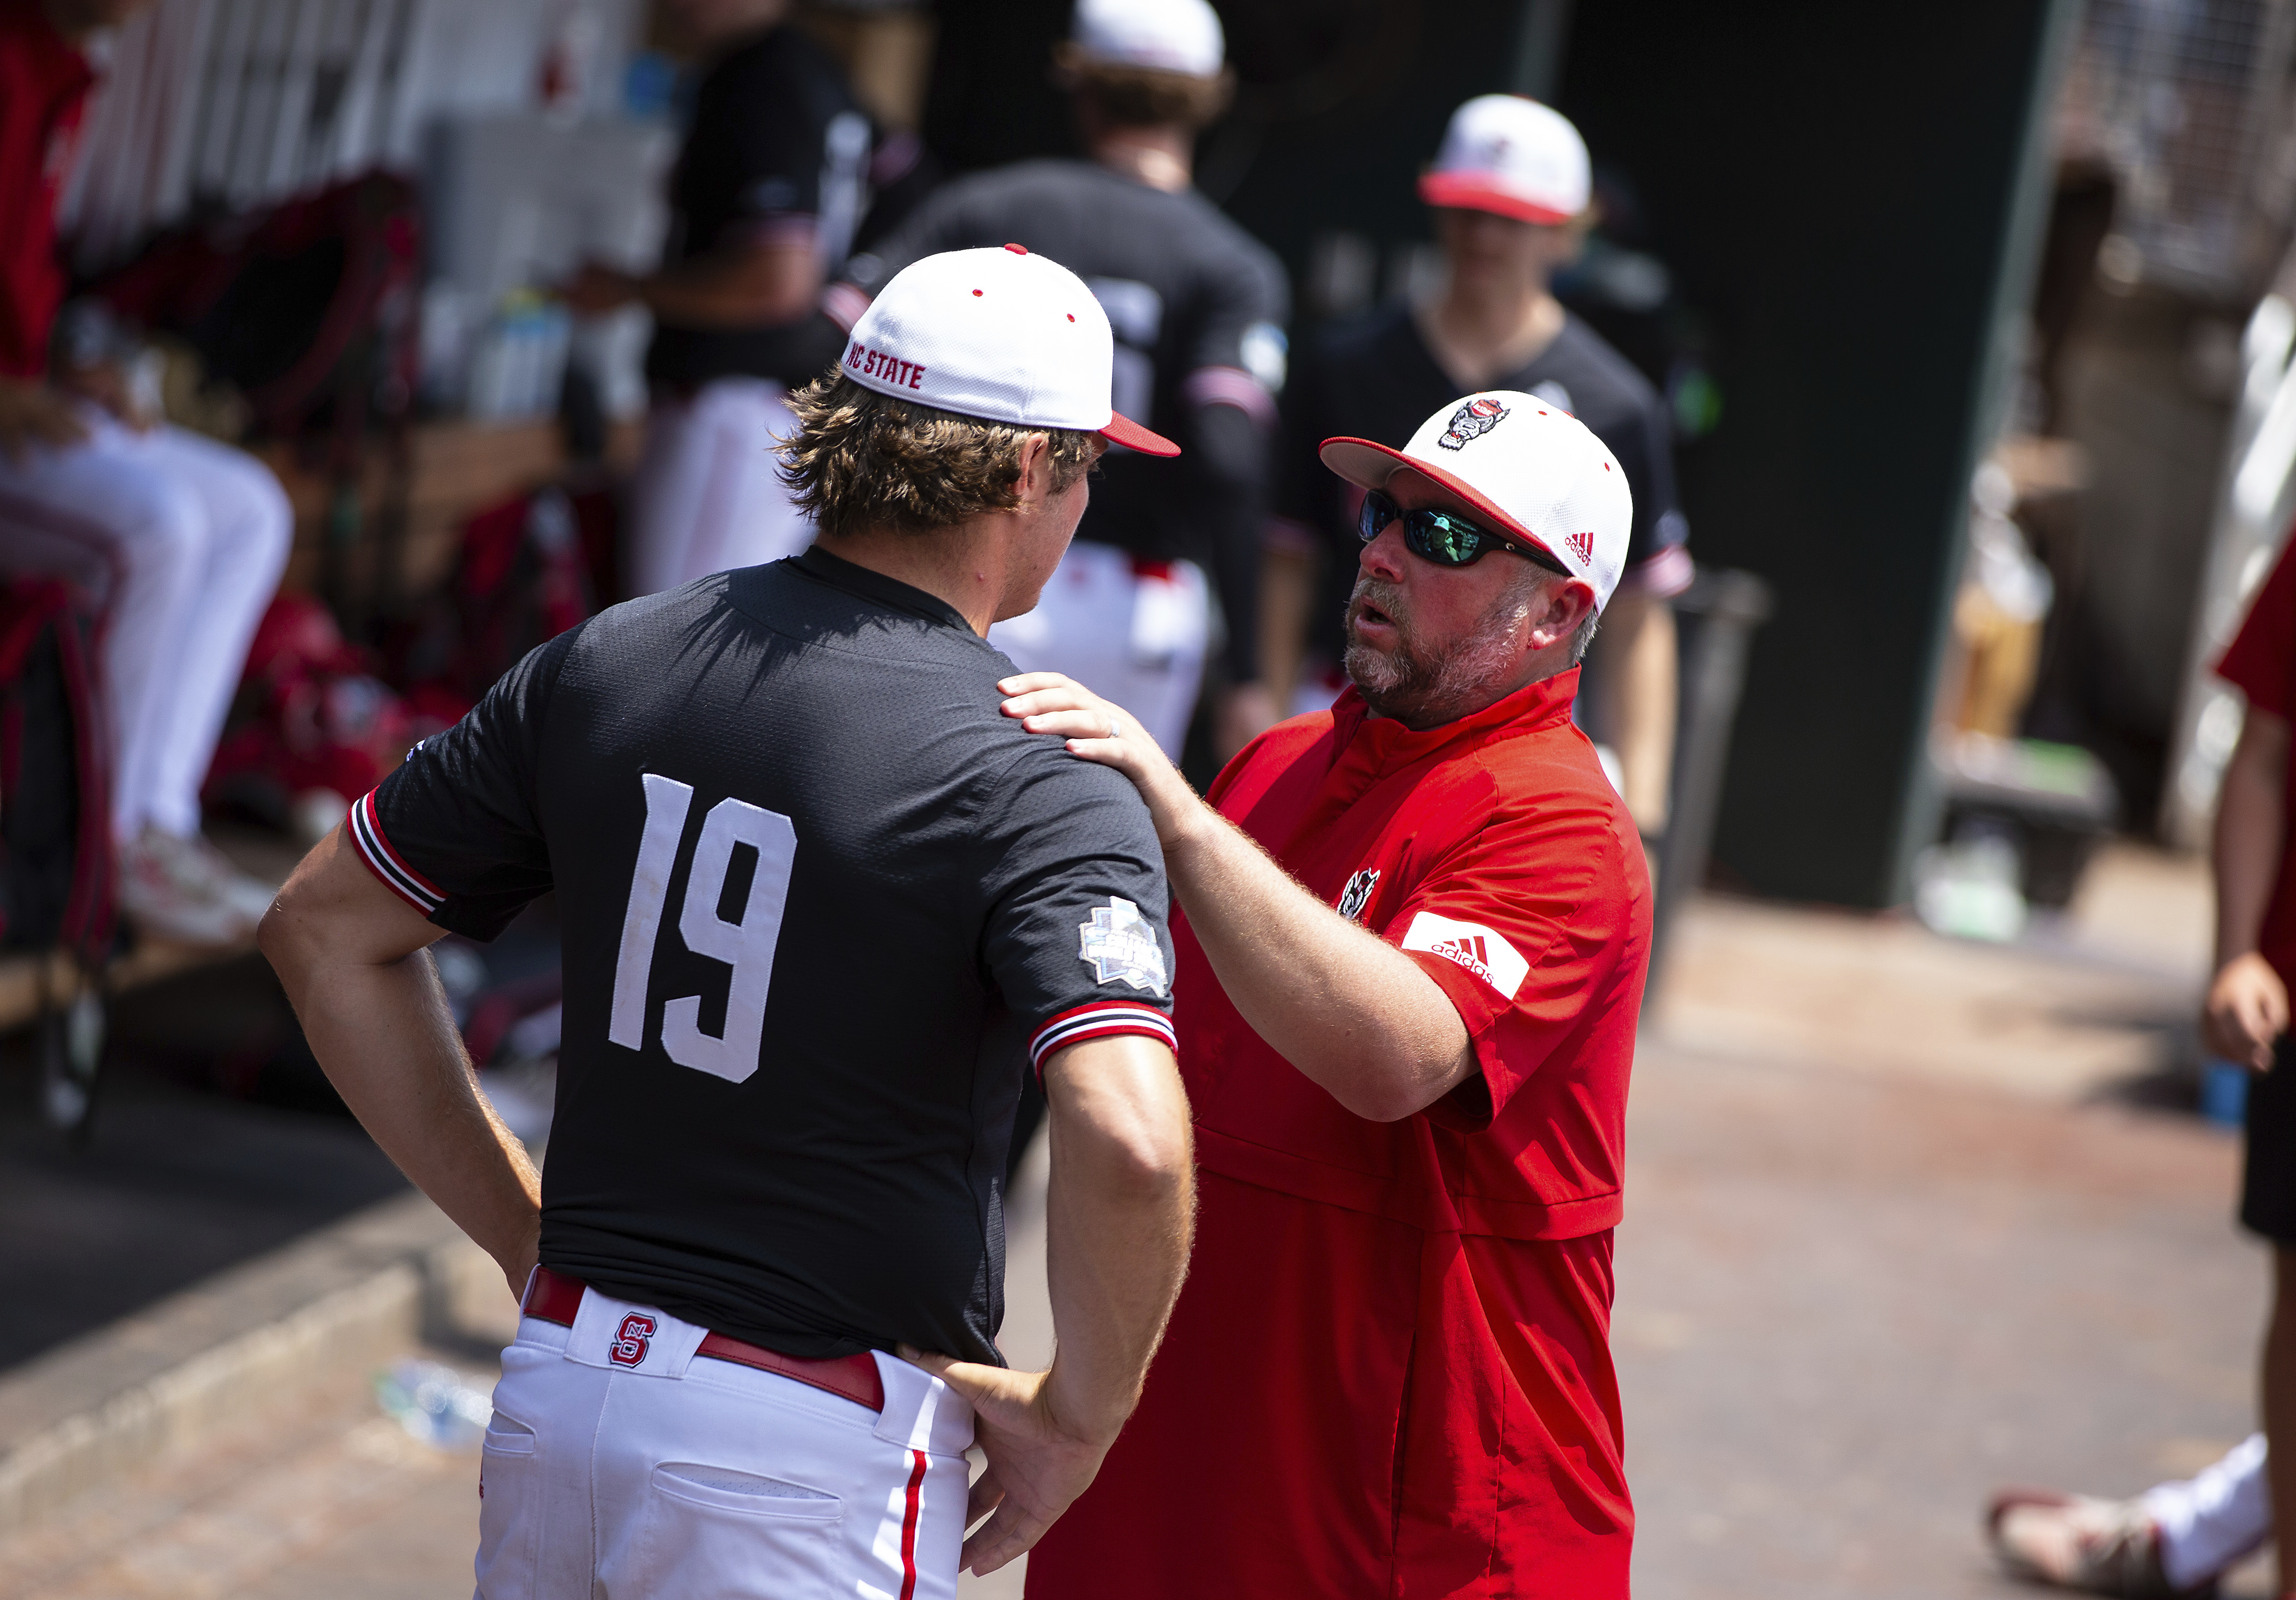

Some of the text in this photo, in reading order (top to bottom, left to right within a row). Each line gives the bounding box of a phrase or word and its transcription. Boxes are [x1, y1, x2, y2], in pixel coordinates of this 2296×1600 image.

[846, 342, 926, 390] NC STATE
[1565, 536, 1591, 567] adidas
[608, 773, 798, 1085] 19
[1431, 944, 1494, 986] adidas
